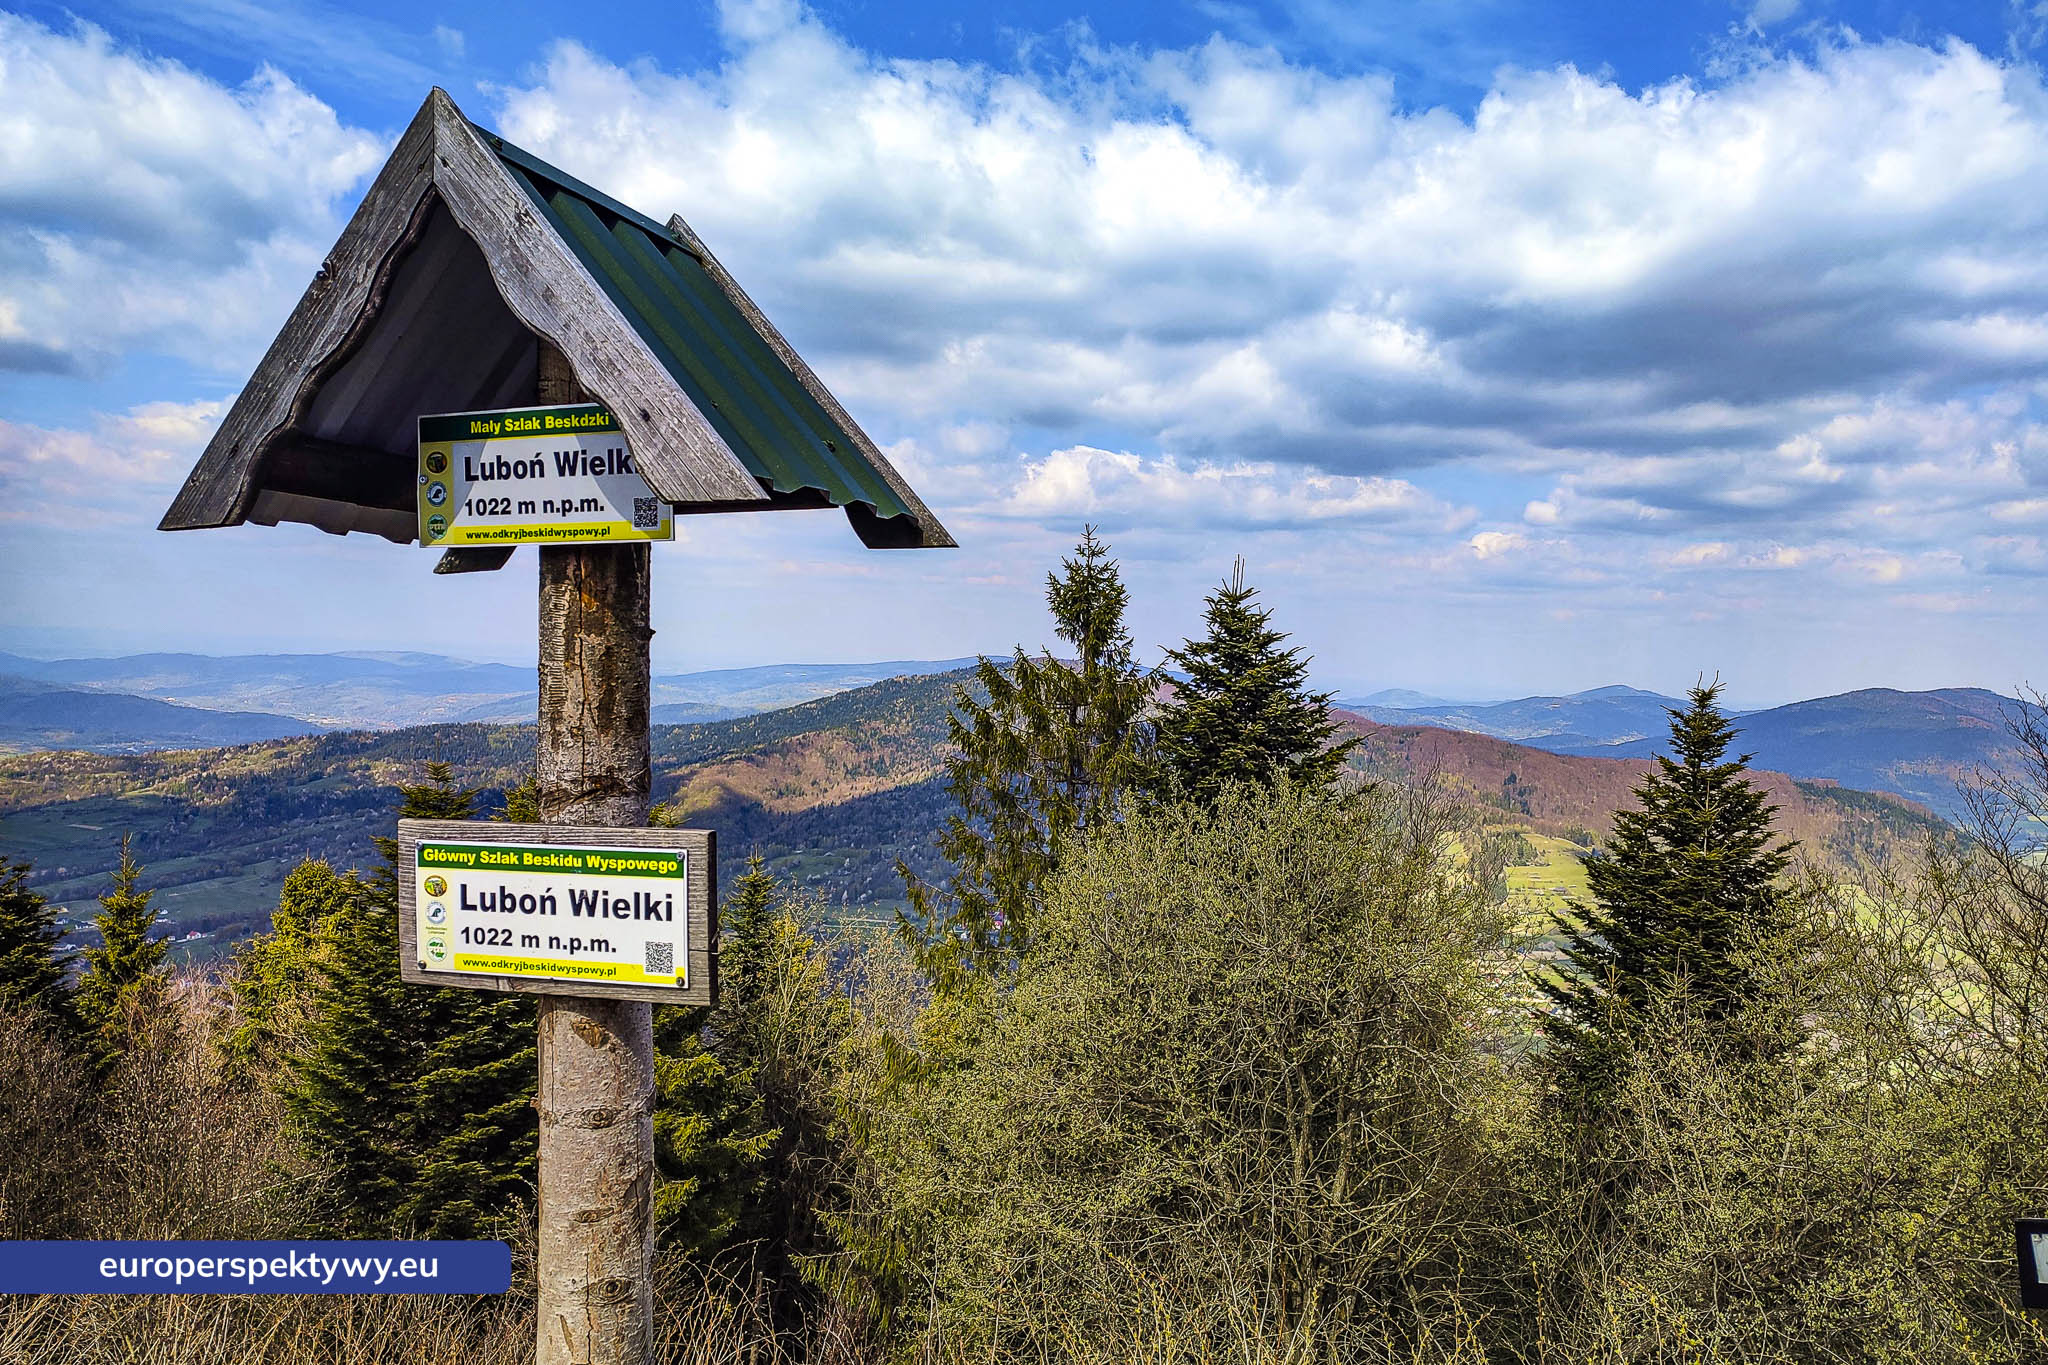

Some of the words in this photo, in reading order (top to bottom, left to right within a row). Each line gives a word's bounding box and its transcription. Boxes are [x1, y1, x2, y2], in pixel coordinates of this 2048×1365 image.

[470, 420, 501, 435] Mały
[504, 416, 541, 432] Szlak
[545, 412, 610, 429] Beskdzki
[464, 452, 545, 482] Luboń
[553, 448, 639, 478] Wielk
[465, 498, 512, 516] 1022
[518, 500, 536, 515] m
[543, 497, 605, 517] n.p.m.
[466, 525, 611, 540] www.odkryjbeskidwyspowy.pl
[423, 848, 476, 866] Główny
[480, 850, 519, 865] Szlak
[523, 852, 582, 868] Beskidu
[586, 855, 678, 873] Wyspowego
[459, 883, 558, 916] Luboń
[568, 888, 673, 922] Wielki
[460, 926, 513, 947] 1022
[521, 933, 540, 949] m
[548, 935, 617, 955] n.p.m.
[462, 958, 617, 976] www.odkryjbeskidwyspowy.pl
